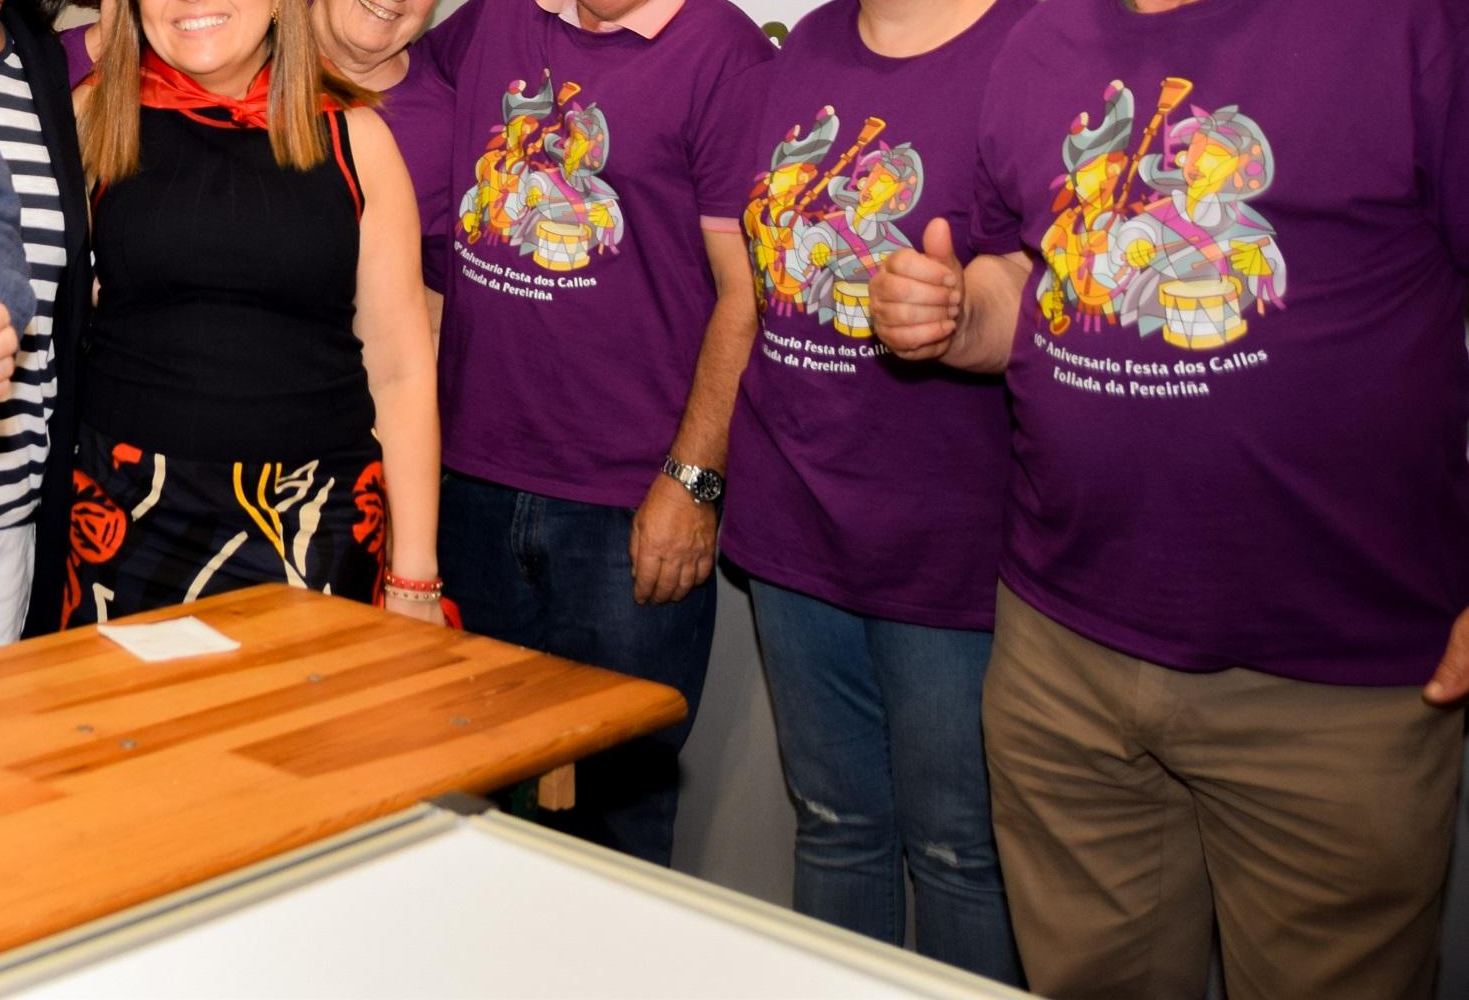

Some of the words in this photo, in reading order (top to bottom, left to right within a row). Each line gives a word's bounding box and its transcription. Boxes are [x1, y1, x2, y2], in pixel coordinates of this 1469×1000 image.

[504, 267, 531, 283] Festa
[534, 275, 555, 287] dos
[557, 277, 597, 288] Callos
[488, 278, 500, 290] da
[503, 282, 553, 301] Pereiriña
[805, 340, 835, 355] Festa
[838, 345, 856, 357] dos
[1046, 341, 1121, 373] Aniversario
[1125, 359, 1169, 376] Festa
[1173, 360, 1205, 375] dos
[1209, 349, 1268, 372] Callos
[784, 354, 798, 367] da
[1053, 366, 1101, 391] Foliada
[1105, 379, 1125, 394] da
[1130, 380, 1209, 396] Pereiriña
